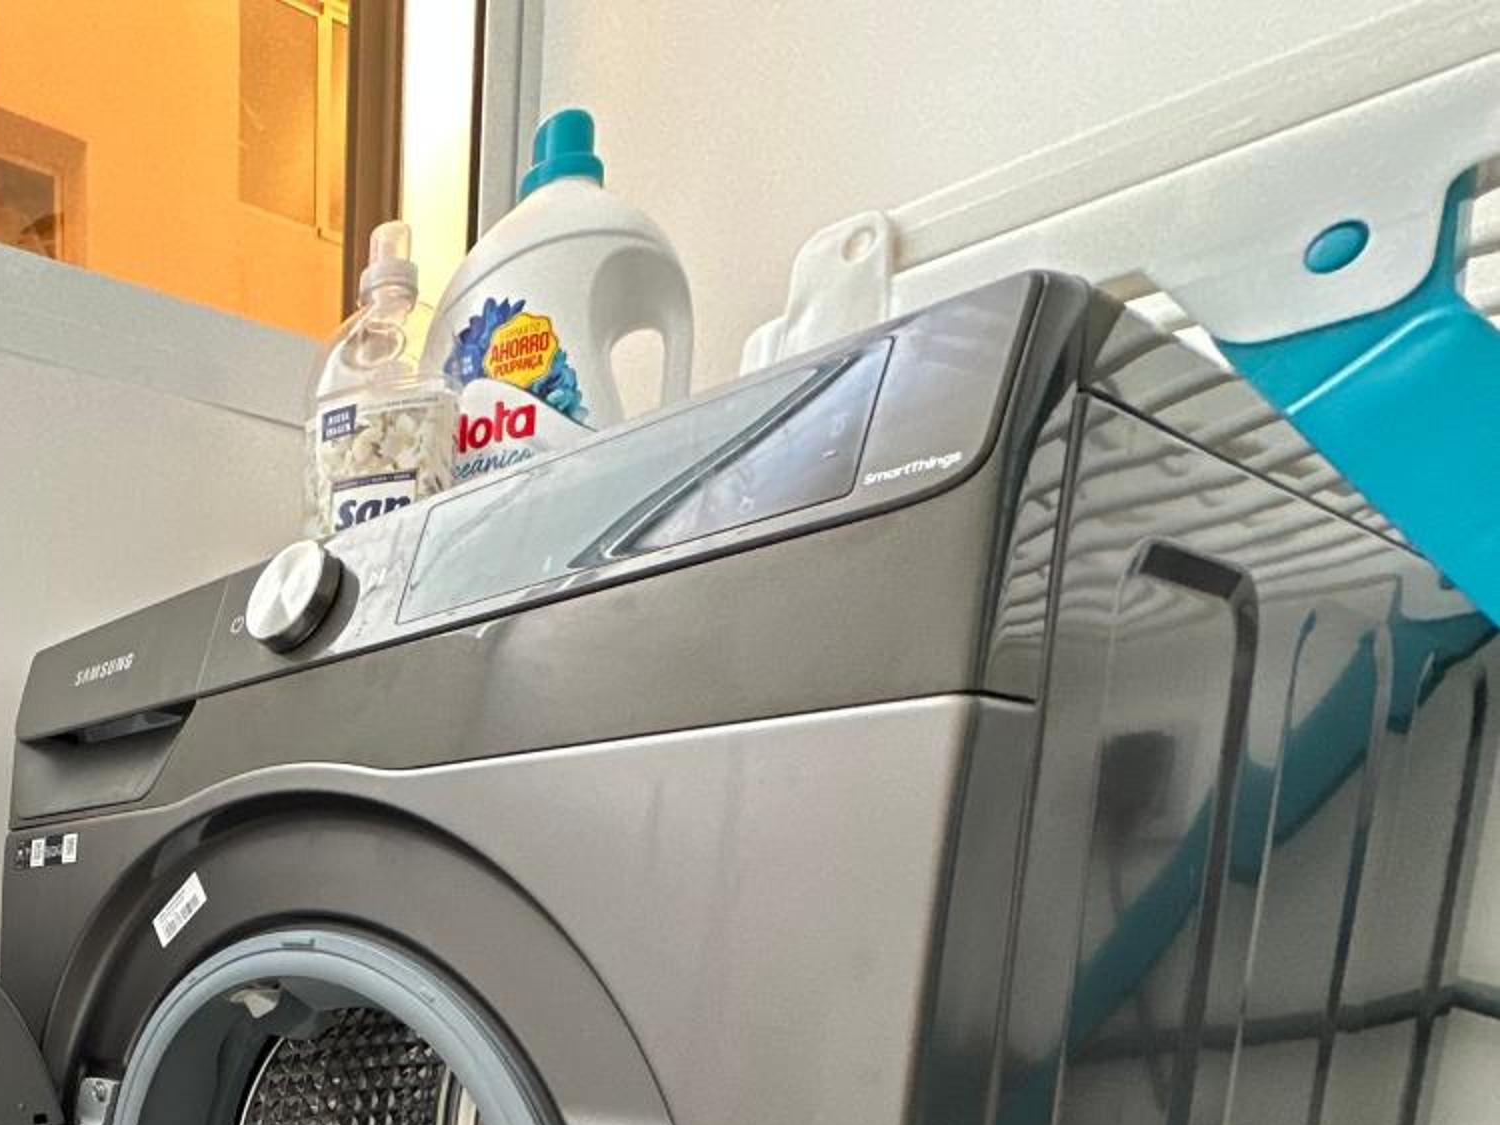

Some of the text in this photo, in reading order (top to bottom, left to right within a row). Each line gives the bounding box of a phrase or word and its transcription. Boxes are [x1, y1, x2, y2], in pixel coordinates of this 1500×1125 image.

[489, 331, 549, 365] AHORRO
[452, 401, 536, 454] lota
[863, 450, 962, 485] SmartThings
[75, 652, 133, 687] SAMSUNG
